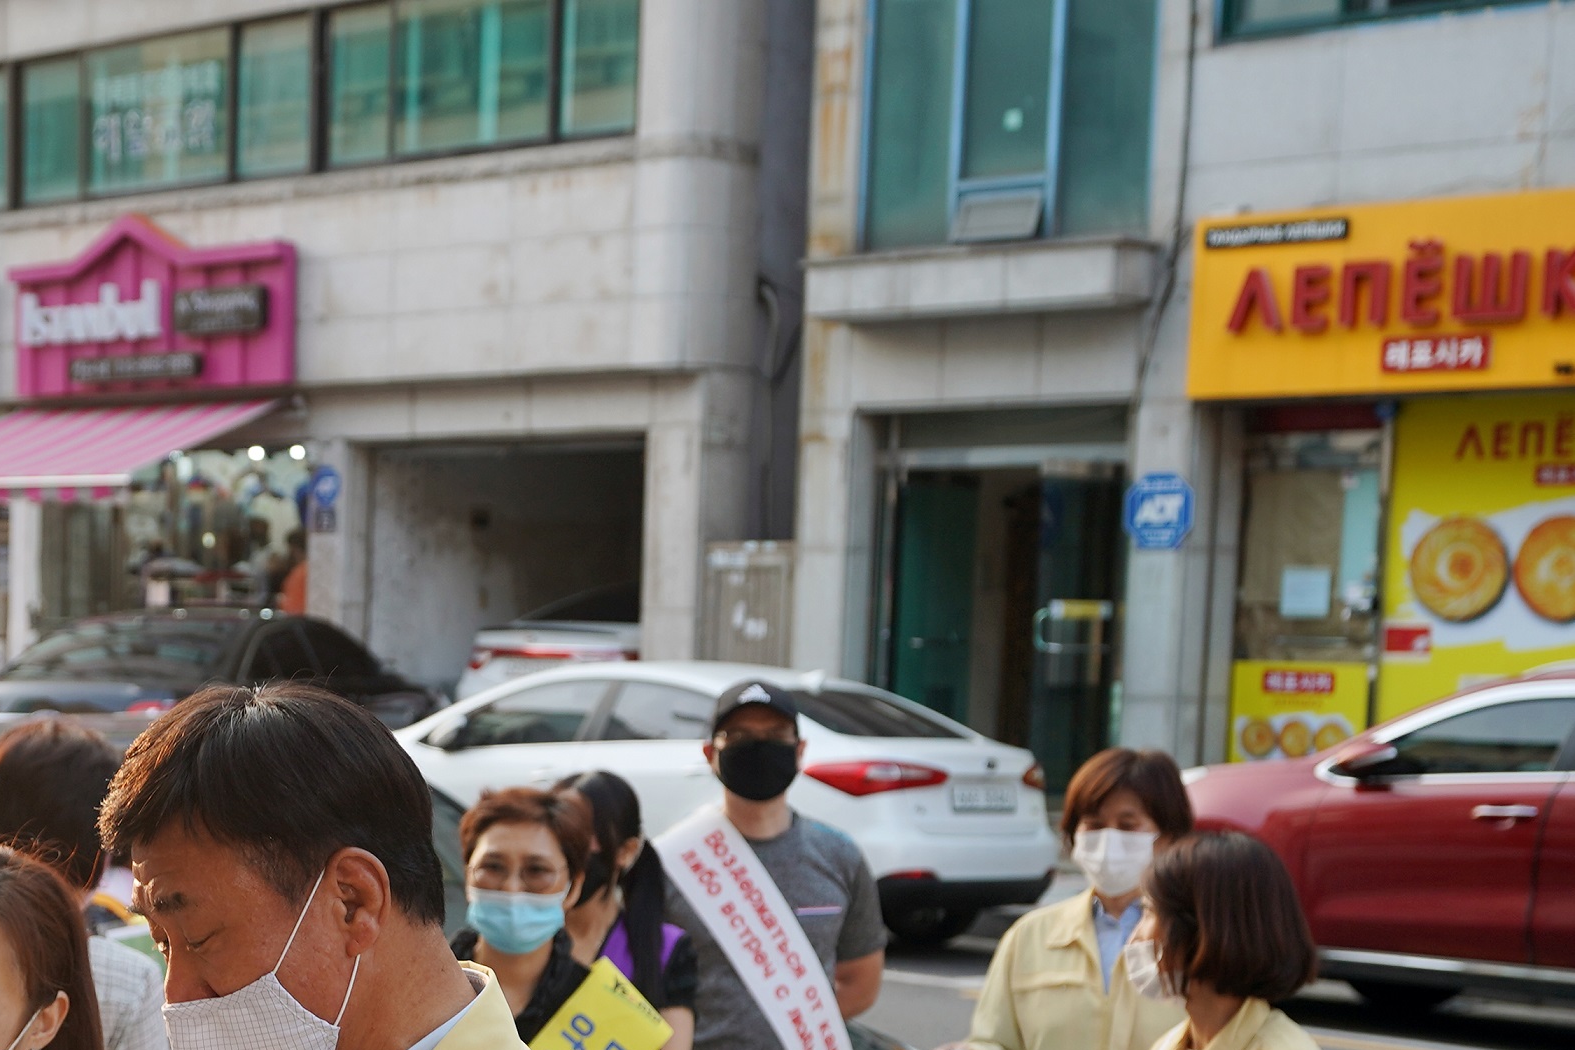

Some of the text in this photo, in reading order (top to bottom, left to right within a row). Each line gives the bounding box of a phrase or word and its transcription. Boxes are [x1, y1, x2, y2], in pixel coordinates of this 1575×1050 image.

[681, 850, 722, 896] либо
[720, 902, 777, 979] встреч
[775, 984, 789, 1001] с
[704, 830, 807, 978] Воздержаться
[805, 985, 823, 1011] от
